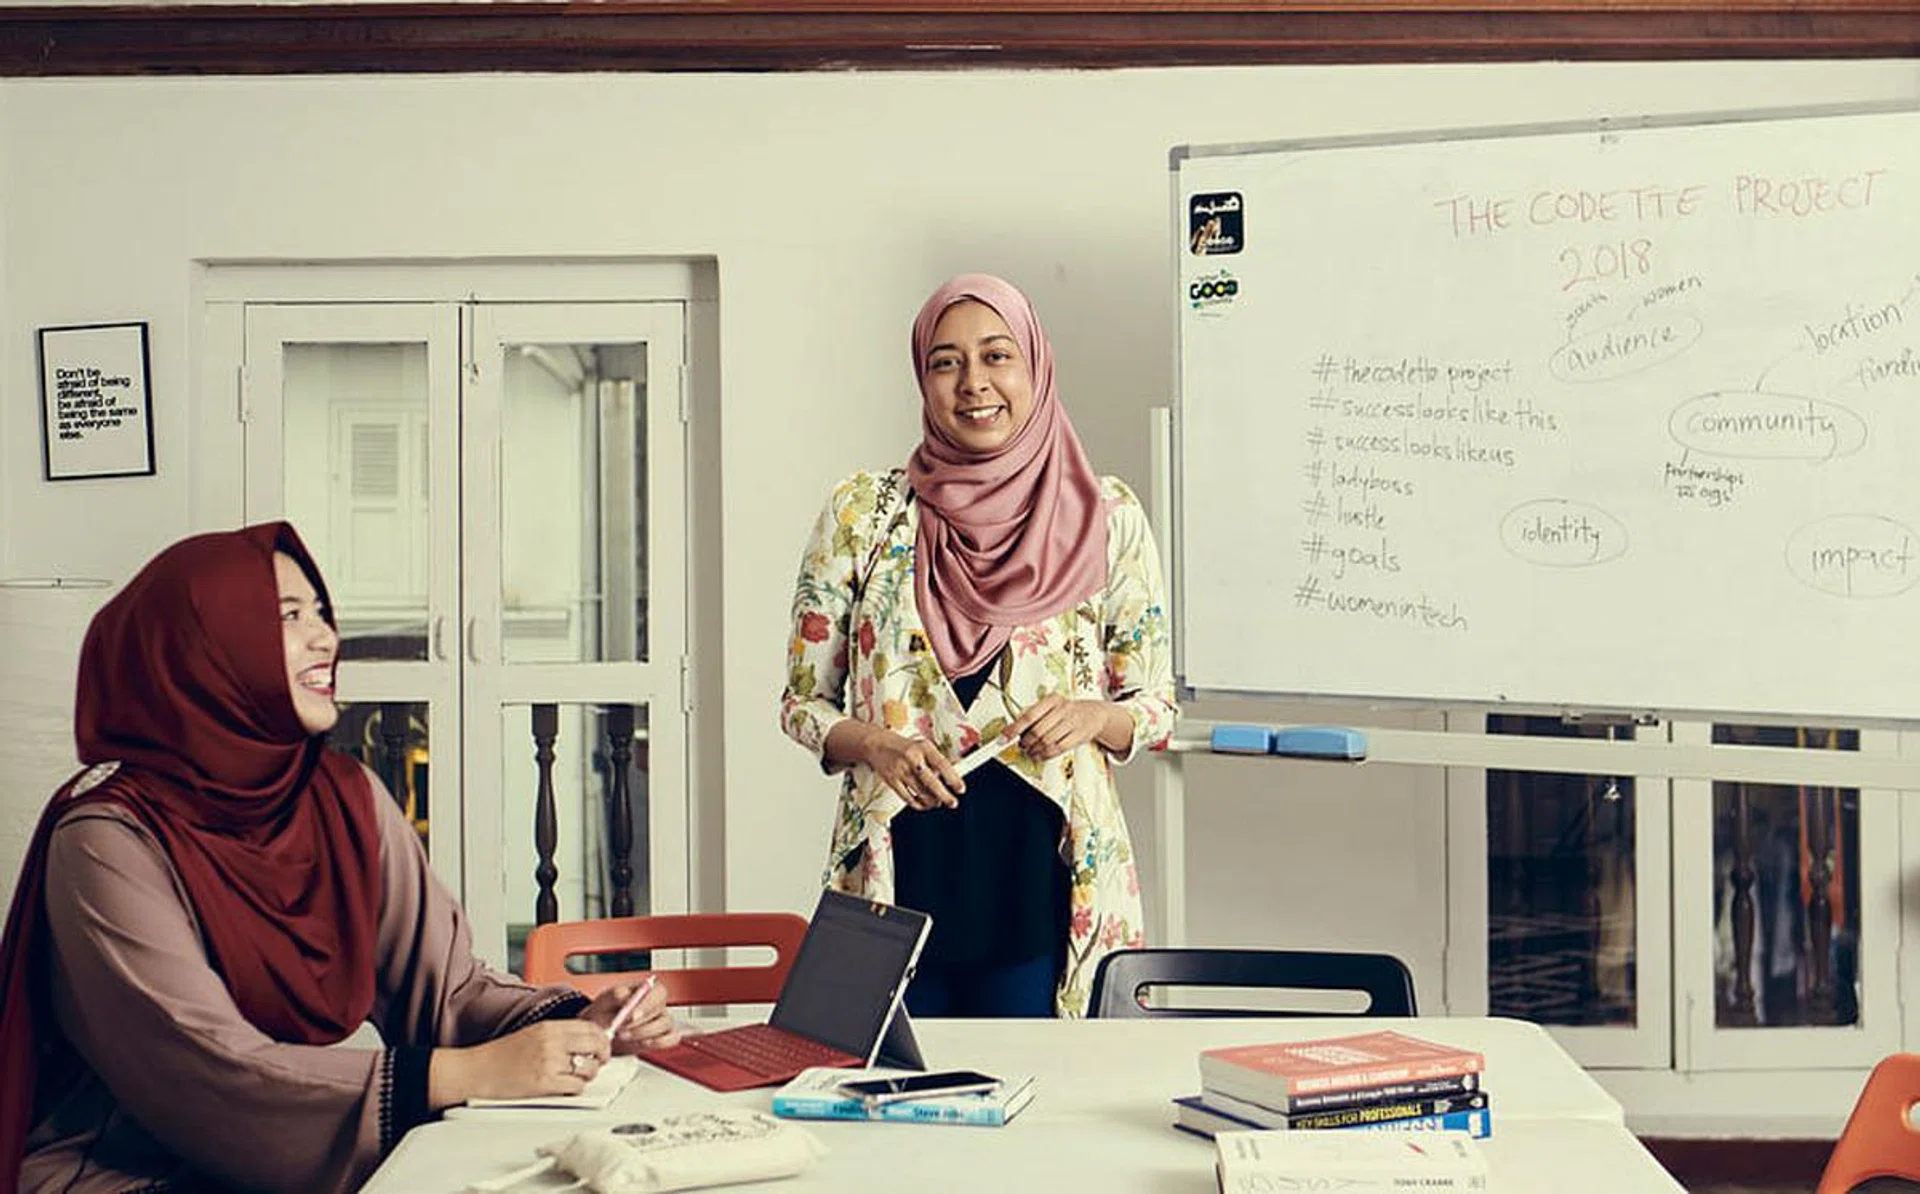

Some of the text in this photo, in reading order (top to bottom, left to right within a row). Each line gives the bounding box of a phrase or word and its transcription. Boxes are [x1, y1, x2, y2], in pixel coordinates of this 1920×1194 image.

[1434, 168, 1888, 237] THE CODETTE PROJECT
[1560, 239, 1653, 291] 2018
[1642, 275, 1703, 307] women
[1566, 326, 1682, 372] audience
[1804, 302, 1903, 355] location
[56, 368, 101, 379] Don't be
[57, 377, 130, 389] afraid of being
[58, 396, 116, 410] be afraid of
[58, 407, 137, 421] being the same
[59, 419, 121, 430] as everyone
[1688, 400, 1838, 460] community
[1301, 532, 1401, 580] #goals
[1522, 515, 1600, 560] identity
[1811, 535, 1916, 598] impact
[1342, 1112, 1359, 1124] FOR
[1360, 1103, 1422, 1122] PROFESSIONALS
